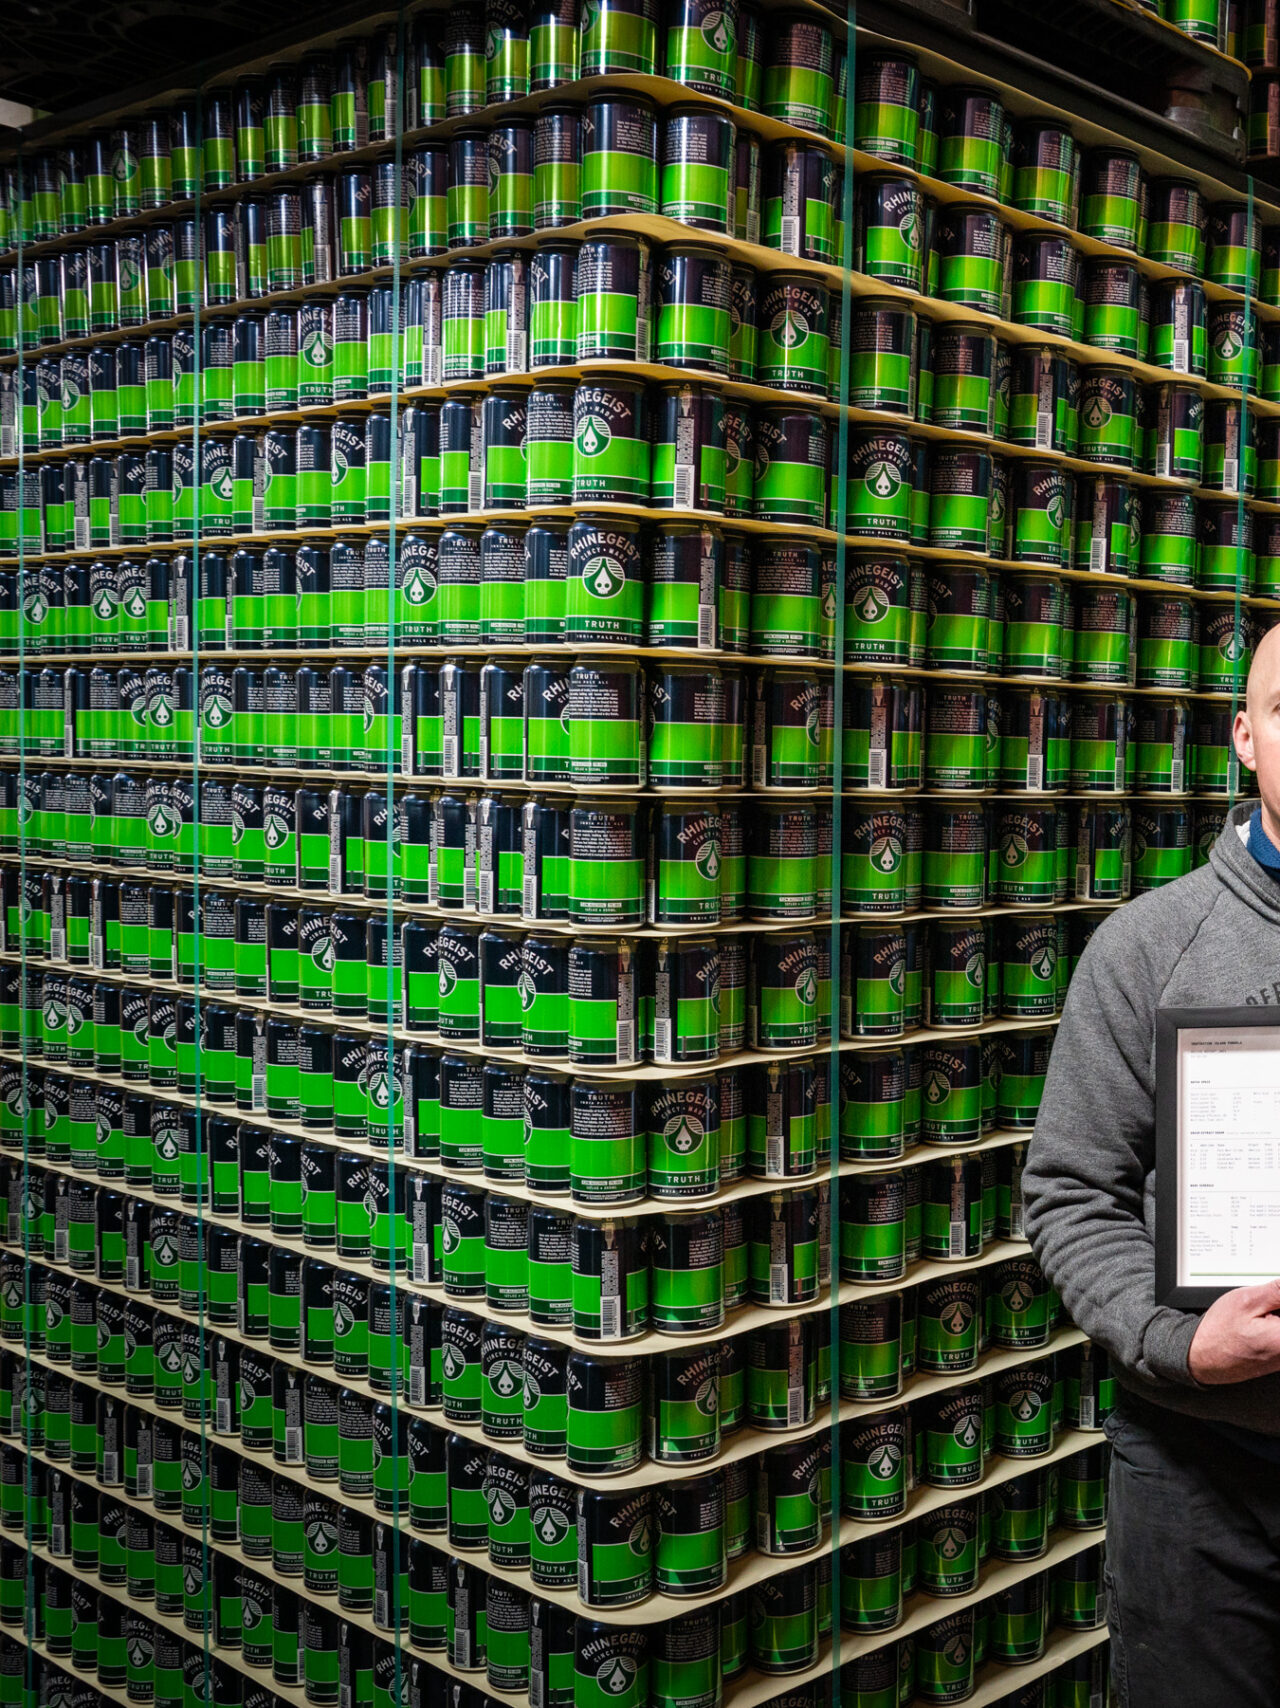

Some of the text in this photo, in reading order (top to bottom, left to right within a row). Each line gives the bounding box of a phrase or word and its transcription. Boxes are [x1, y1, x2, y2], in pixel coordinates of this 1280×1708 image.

[773, 370, 804, 378] TRUTH
[576, 479, 606, 487] TRUTH
[867, 518, 897, 527] TRUTH
[570, 532, 640, 561] RHINEGEIST
[584, 620, 620, 629] TRUTH
[650, 1092, 717, 1117] RHINEGEIST
[666, 1176, 701, 1184] TRUTH
[491, 1417, 523, 1425] TRUTH
[536, 1564, 566, 1573] TRUTH
